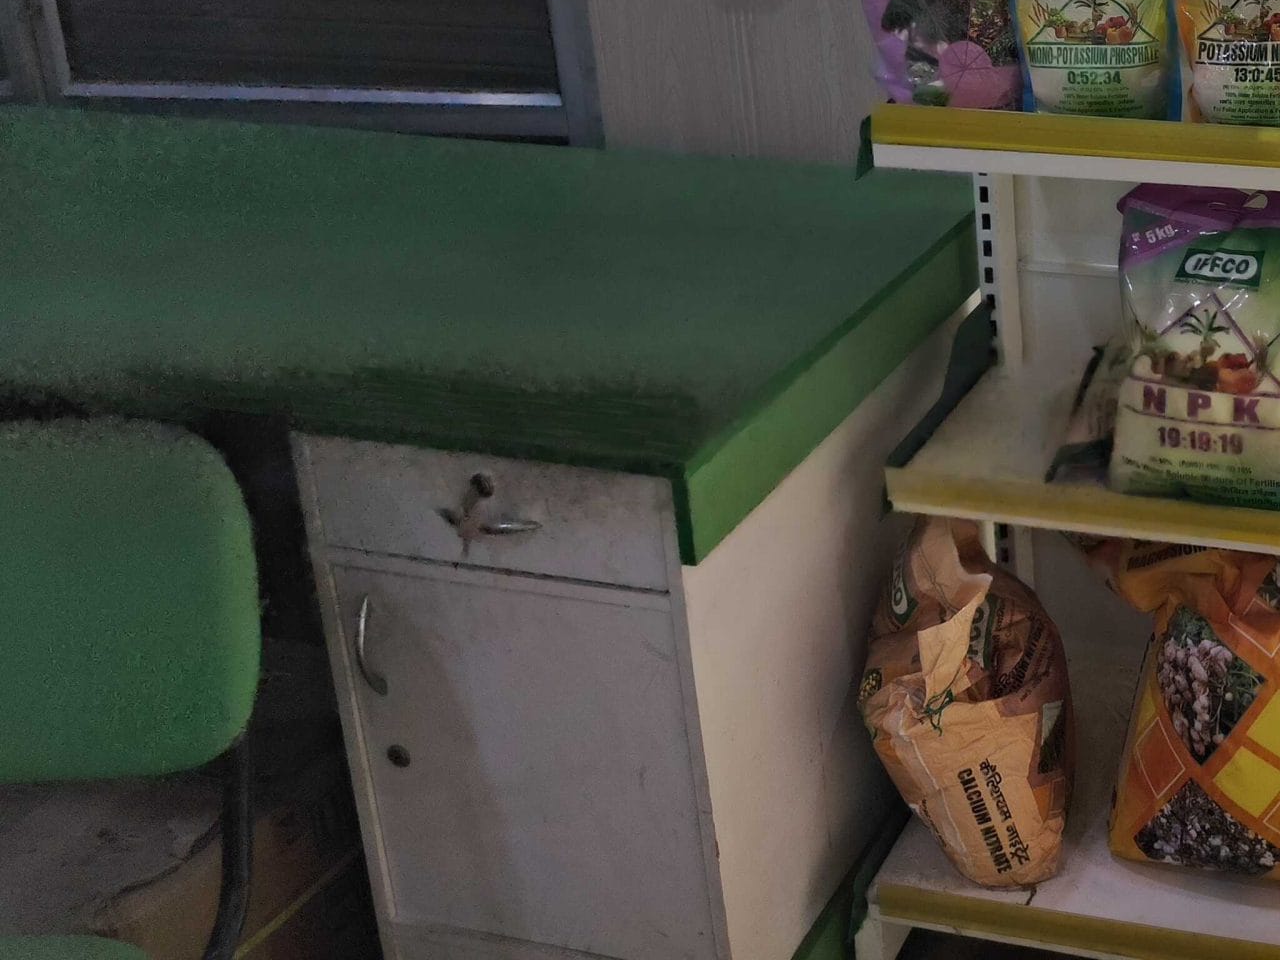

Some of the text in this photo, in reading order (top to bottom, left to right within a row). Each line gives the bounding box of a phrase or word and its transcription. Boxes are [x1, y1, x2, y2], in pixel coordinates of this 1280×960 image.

[1199, 41, 1268, 63] POTASSIUM
[1192, 255, 1250, 275] IFFCO
[957, 767, 1013, 874] CALCIUM NITRATE
